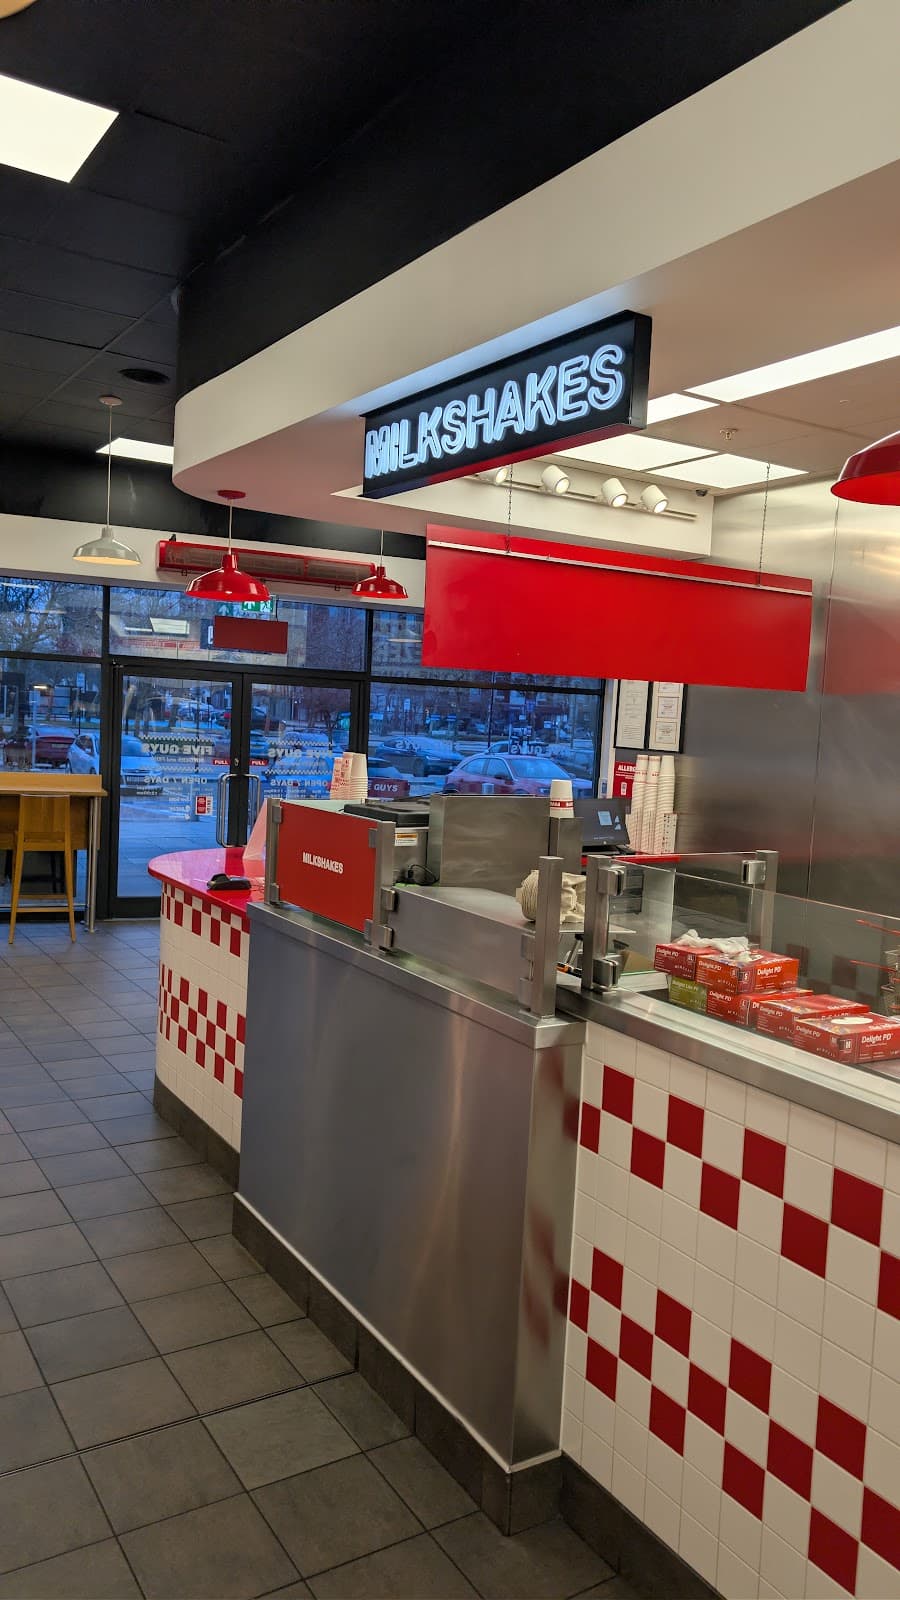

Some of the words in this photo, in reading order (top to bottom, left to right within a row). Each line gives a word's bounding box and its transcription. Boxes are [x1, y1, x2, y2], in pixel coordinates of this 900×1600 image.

[365, 344, 625, 479] MILKSHAKES
[373, 783, 398, 792] GUYS
[302, 851, 344, 875] MILKSHAKES
[656, 947, 672, 956] Delight
[698, 960, 713, 970] Delight
[757, 967, 774, 976] Delight
[709, 990, 724, 1000] Delight
[861, 1034, 882, 1044] Delight
[882, 1033, 892, 1041] PD
